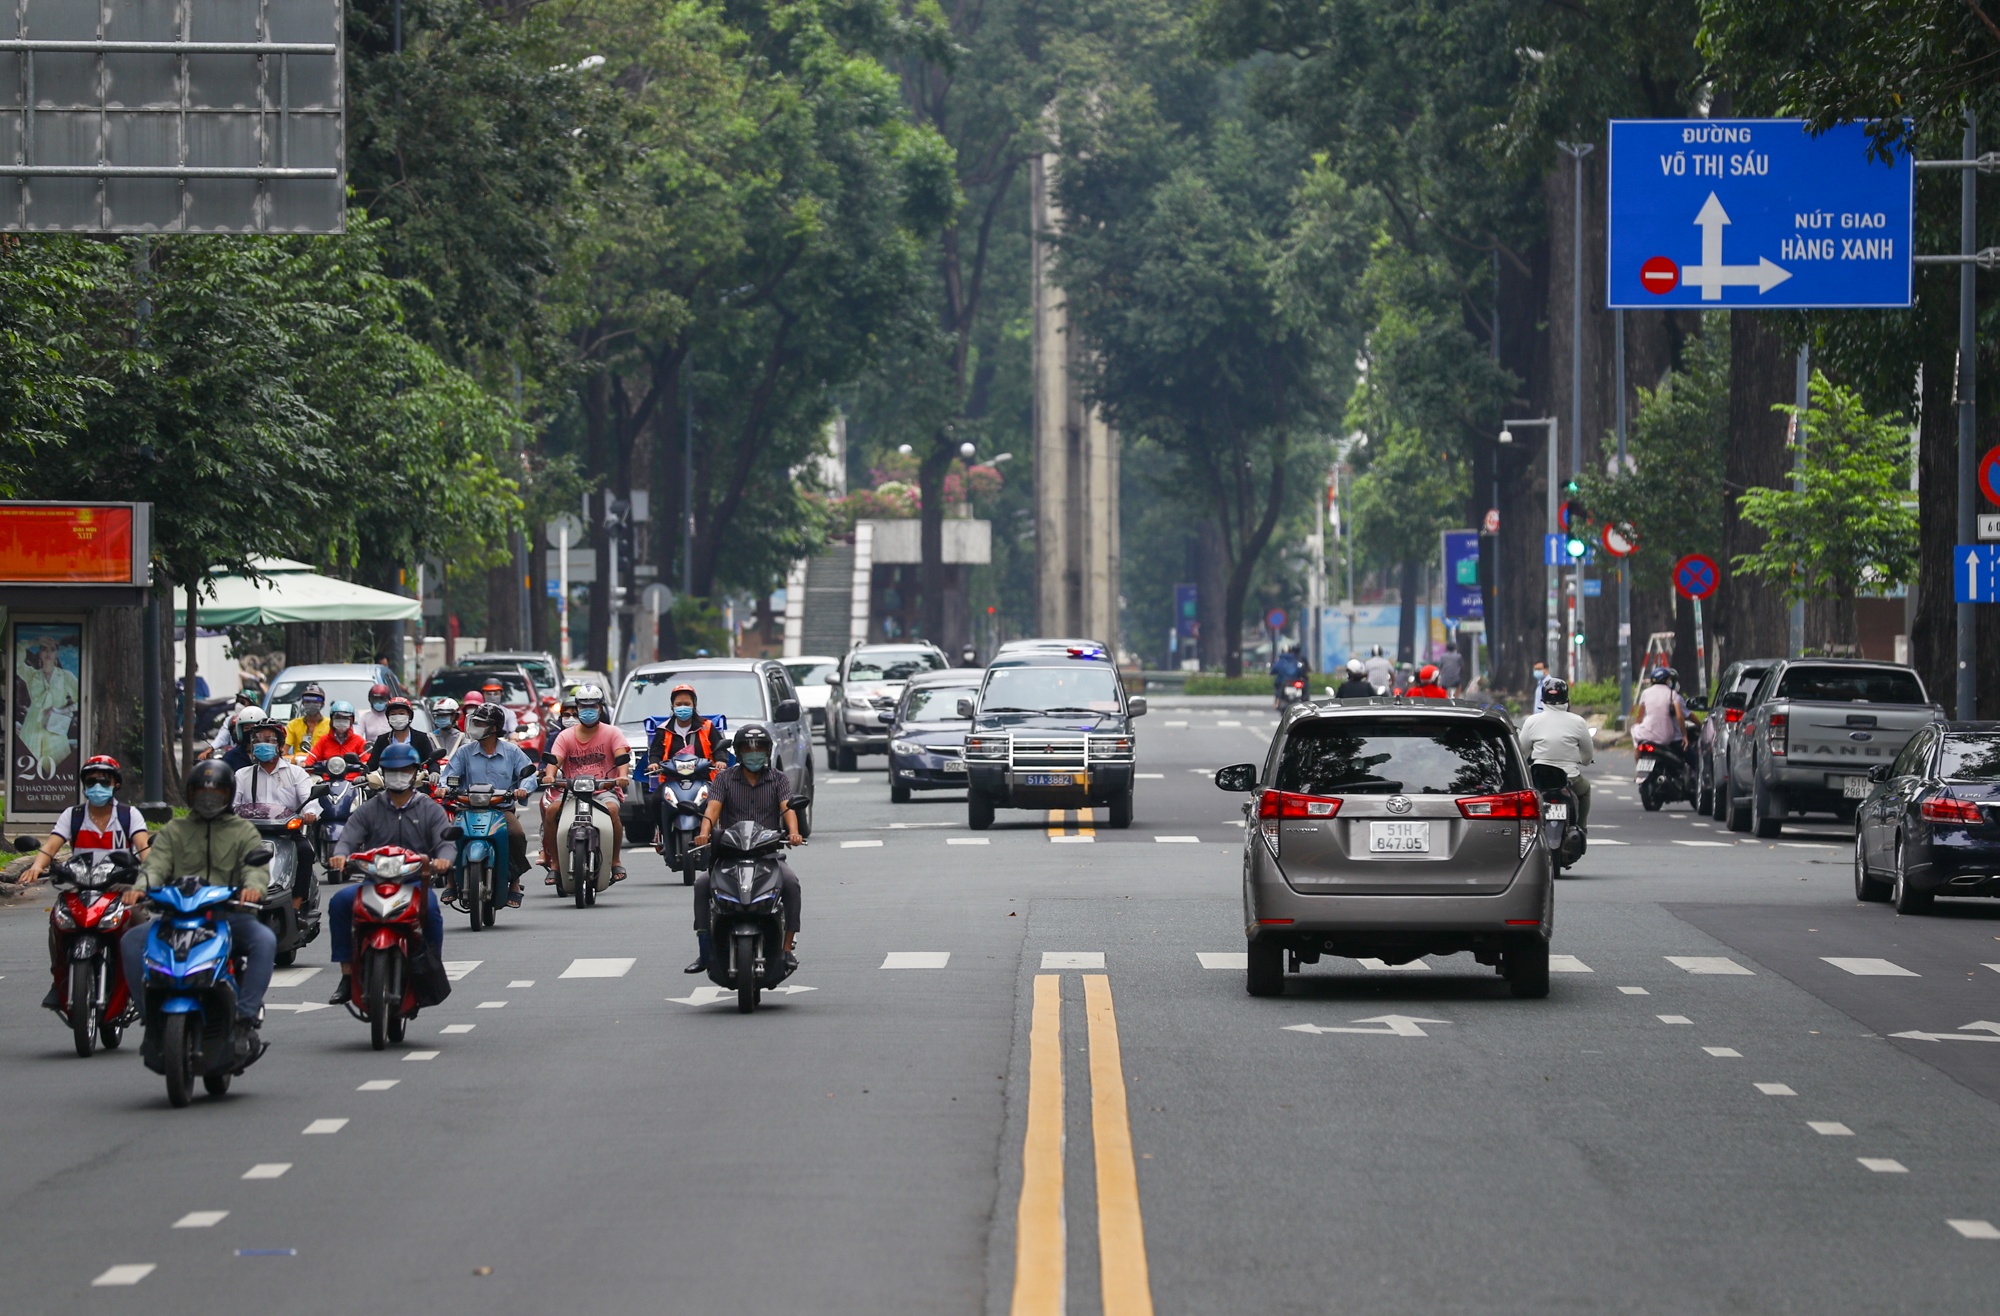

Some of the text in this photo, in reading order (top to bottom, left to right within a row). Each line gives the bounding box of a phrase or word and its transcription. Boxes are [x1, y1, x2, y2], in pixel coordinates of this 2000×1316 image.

[1682, 124, 1752, 144] ĐƯỜNG
[1660, 150, 1769, 179] VÕ THỊ SÁU
[1794, 208, 1886, 229] NÚT GIAO
[1781, 233, 1893, 260] HÀNG XANH
[16, 755, 57, 781] 20
[1387, 825, 1412, 836] 51H
[1377, 838, 1422, 849] 847.05
